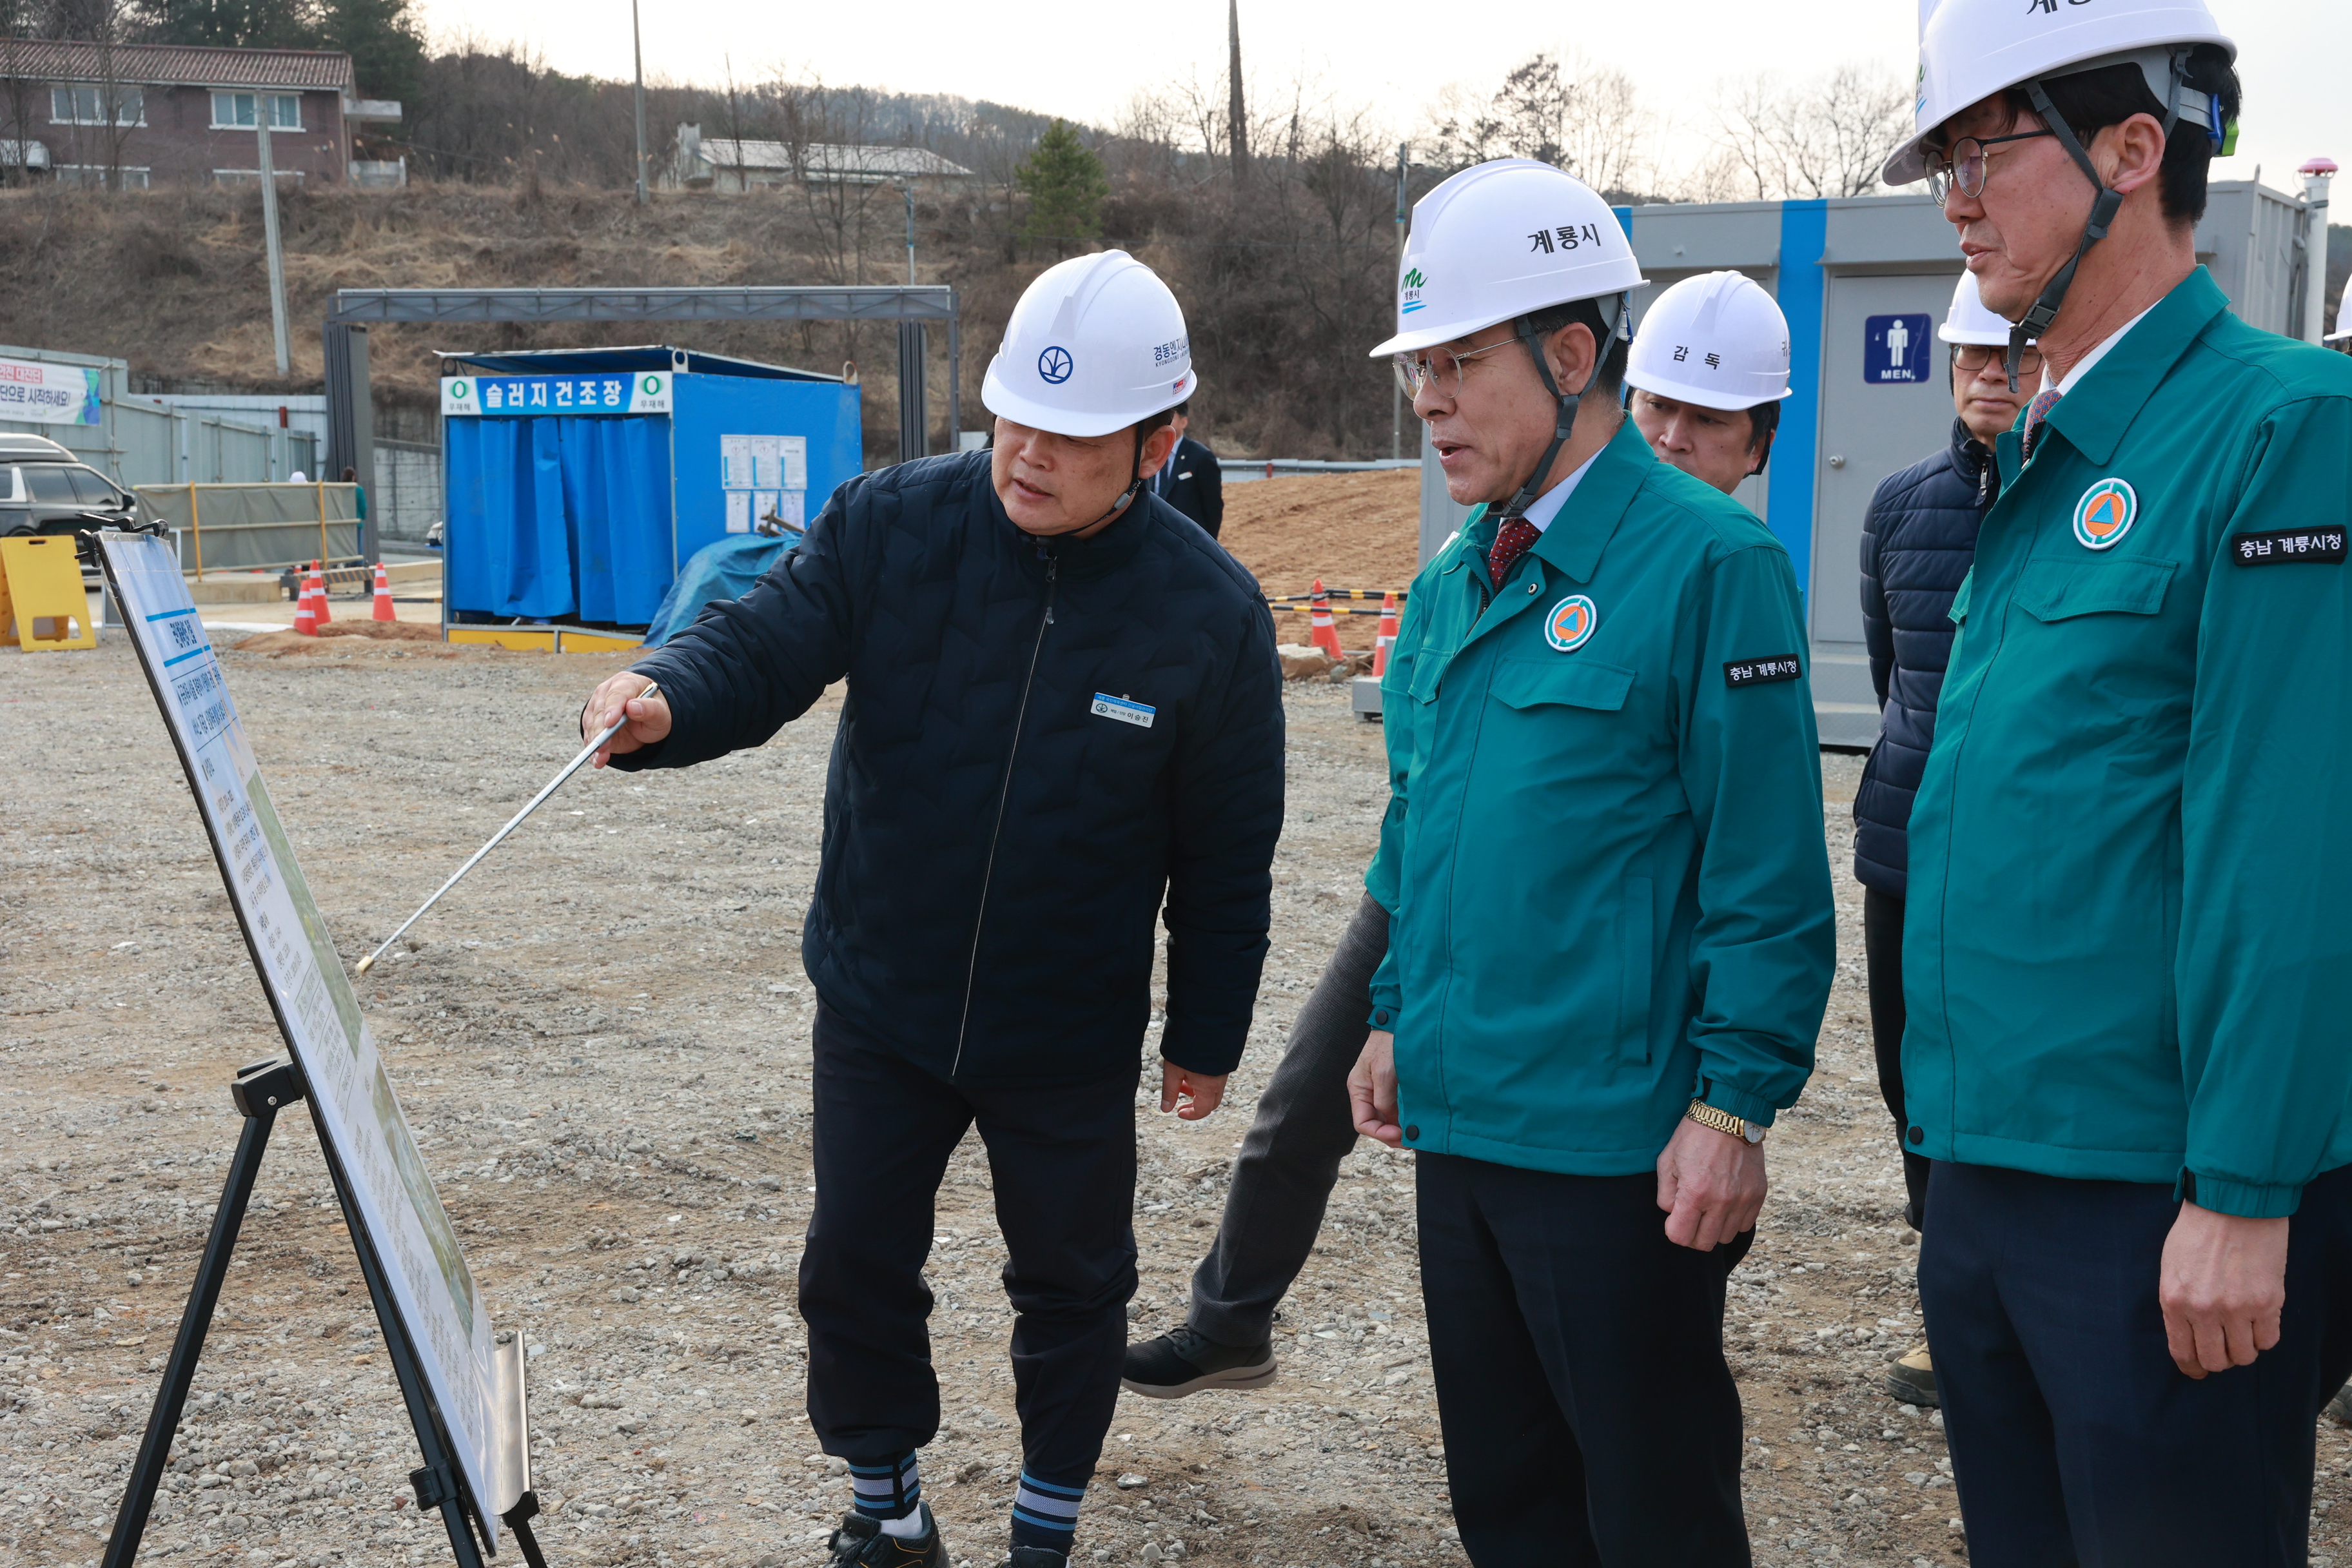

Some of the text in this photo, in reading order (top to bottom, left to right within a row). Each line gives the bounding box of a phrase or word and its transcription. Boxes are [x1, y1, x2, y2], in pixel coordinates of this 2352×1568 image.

[1527, 223, 1601, 254] 계룡시
[1404, 289, 1420, 300] 계룡시
[1155, 355, 1180, 368] KYONGDONG
[1881, 369, 1911, 380] MEN
[28, 387, 70, 407] 시작하세요!
[2240, 534, 2341, 558] 충남 계룡시청
[1730, 660, 1797, 681] 충남 계룡시청
